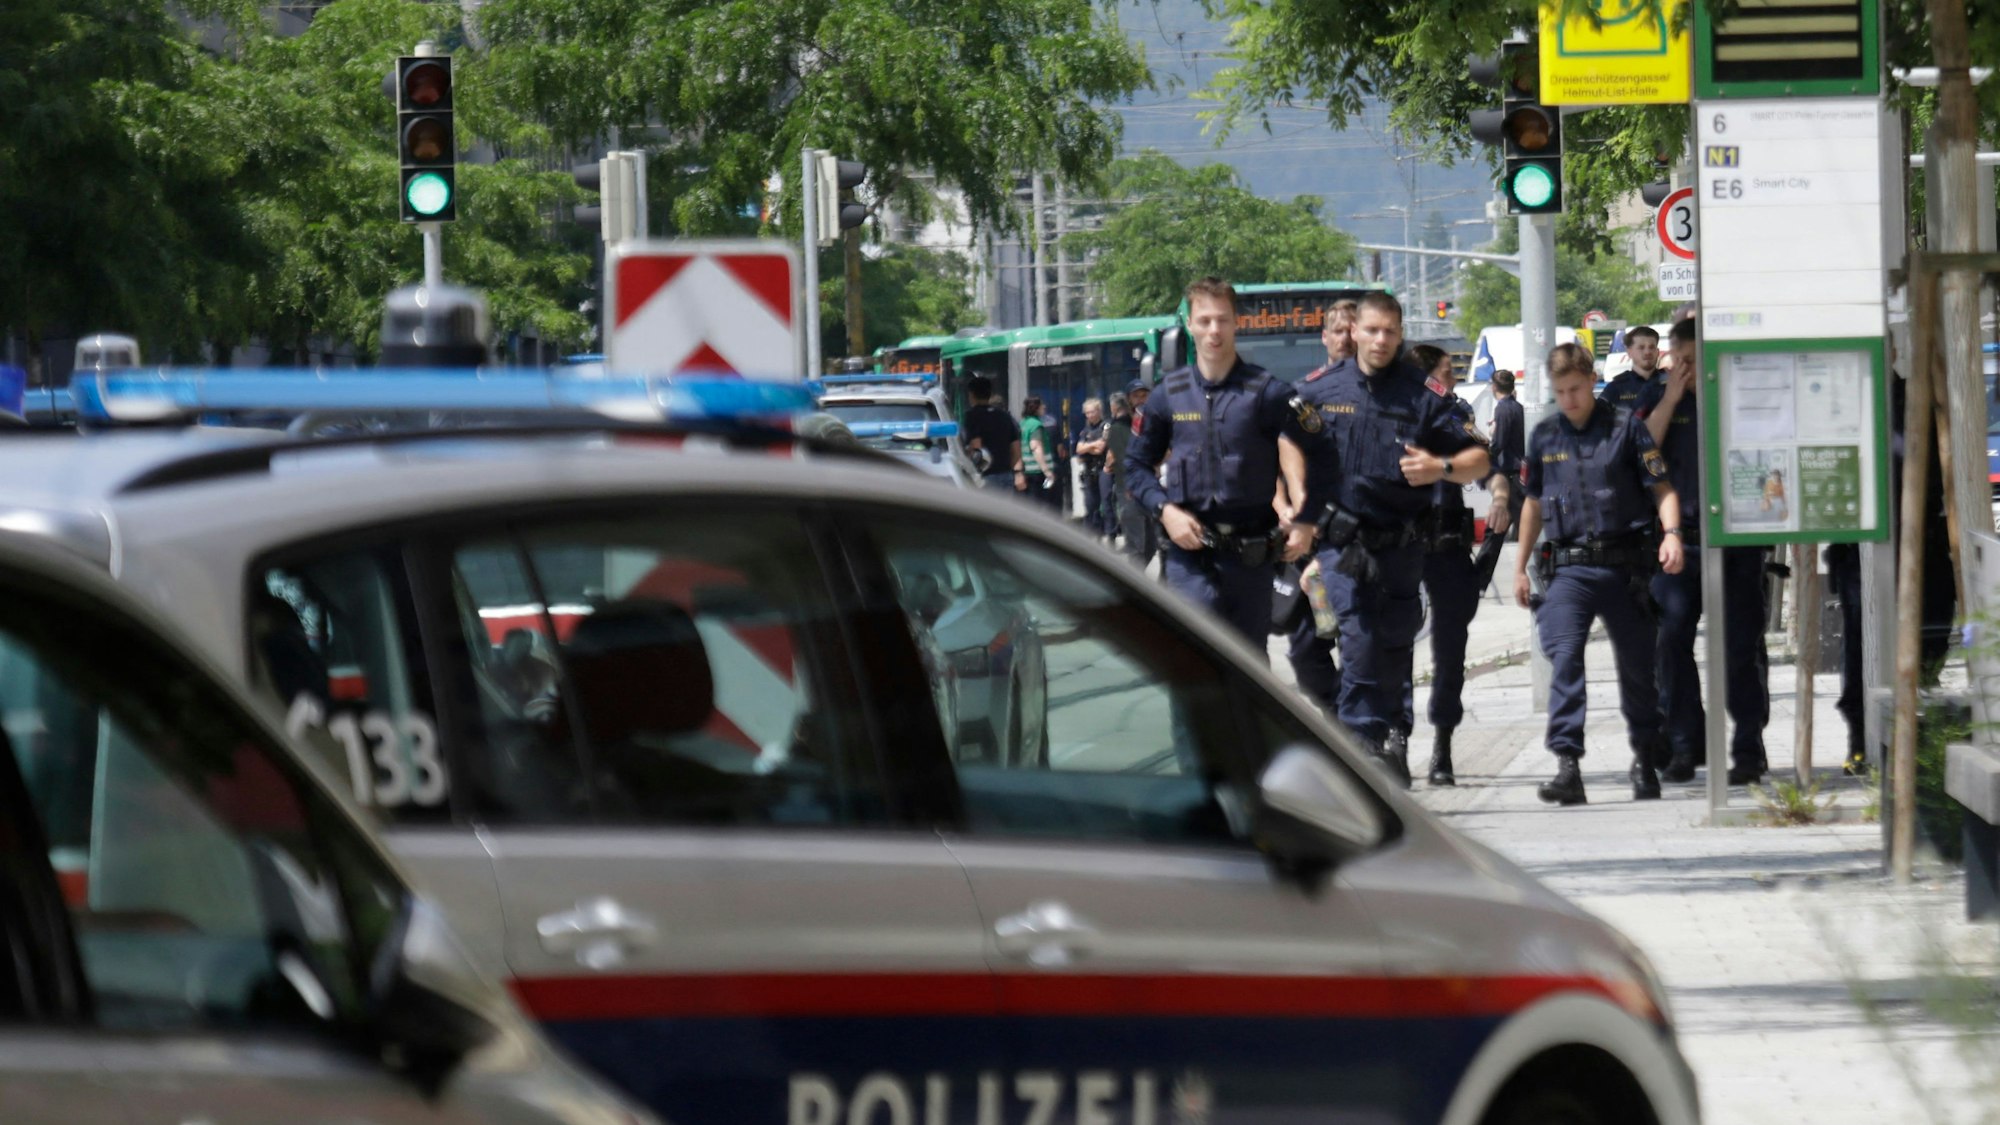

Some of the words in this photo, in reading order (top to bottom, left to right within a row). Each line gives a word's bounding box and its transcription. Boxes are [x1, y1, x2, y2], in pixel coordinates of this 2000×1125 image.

[1563, 87, 1659, 98] Helmut-List-Halle
[1713, 113, 1727, 134] 6
[1708, 147, 1738, 167] N1
[1712, 179, 1743, 199] E6
[1752, 178, 1786, 189] Smart
[1788, 178, 1811, 190] City
[1661, 270, 1673, 280] an
[1666, 286, 1684, 296] von
[1321, 403, 1355, 415] POLIZEI
[329, 712, 445, 806] 133
